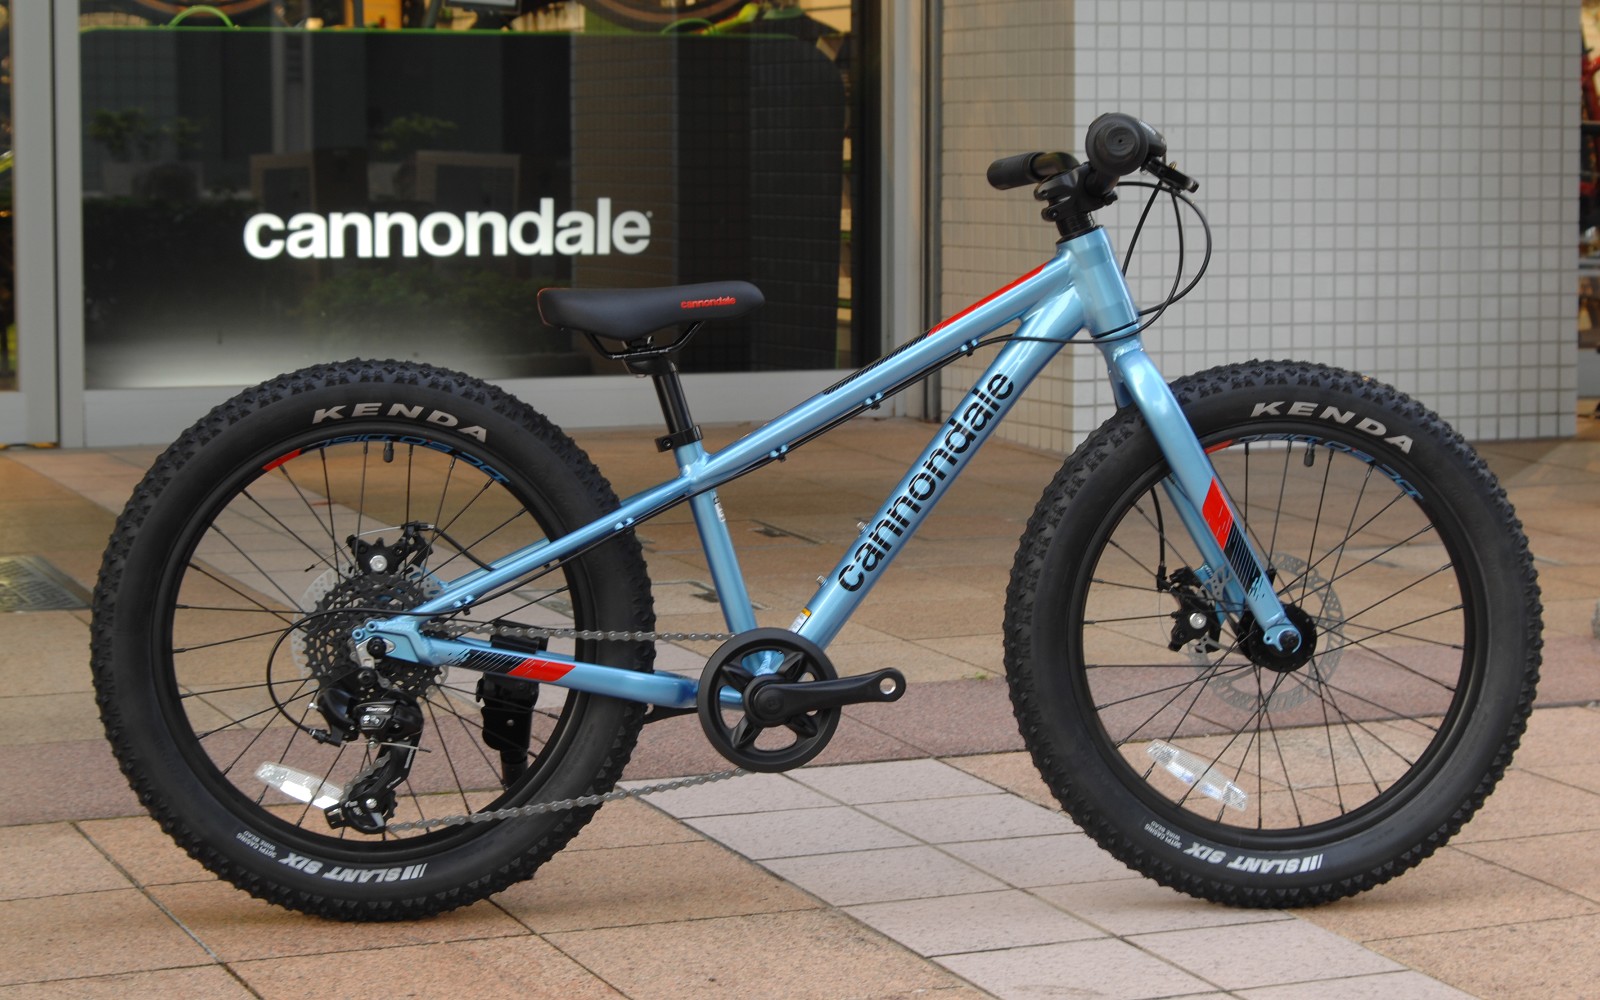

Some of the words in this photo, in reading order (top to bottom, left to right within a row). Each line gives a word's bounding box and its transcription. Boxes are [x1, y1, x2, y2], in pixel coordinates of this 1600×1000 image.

[243, 198, 651, 259] cannondale
[681, 296, 736, 309] cannondale
[312, 402, 488, 444] KENDA
[1250, 401, 1414, 454] KENDA
[838, 373, 1014, 592] cannondale
[278, 852, 324, 874] SIX
[1183, 842, 1227, 864] SIX
[322, 866, 404, 883] SLANT
[1227, 856, 1301, 874] SLANT
